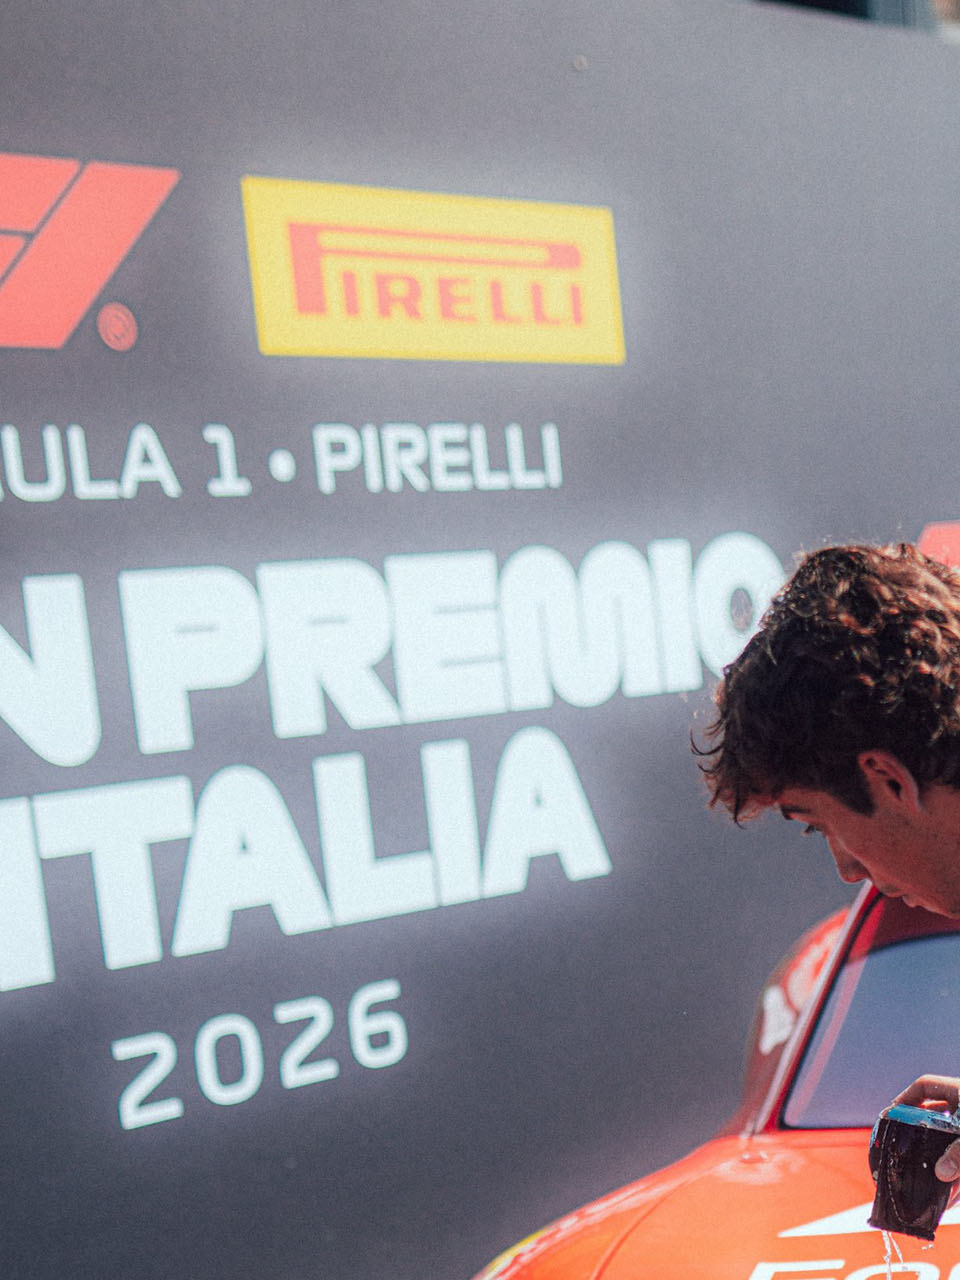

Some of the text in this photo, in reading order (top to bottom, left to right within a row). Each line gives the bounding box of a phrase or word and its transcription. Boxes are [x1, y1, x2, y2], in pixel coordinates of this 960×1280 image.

[286, 220, 584, 328] PIRELLI
[0, 422, 562, 502] ULA 1 PIRELLI
[118, 531, 788, 755] PREMIO
[111, 979, 409, 1131] 2026
